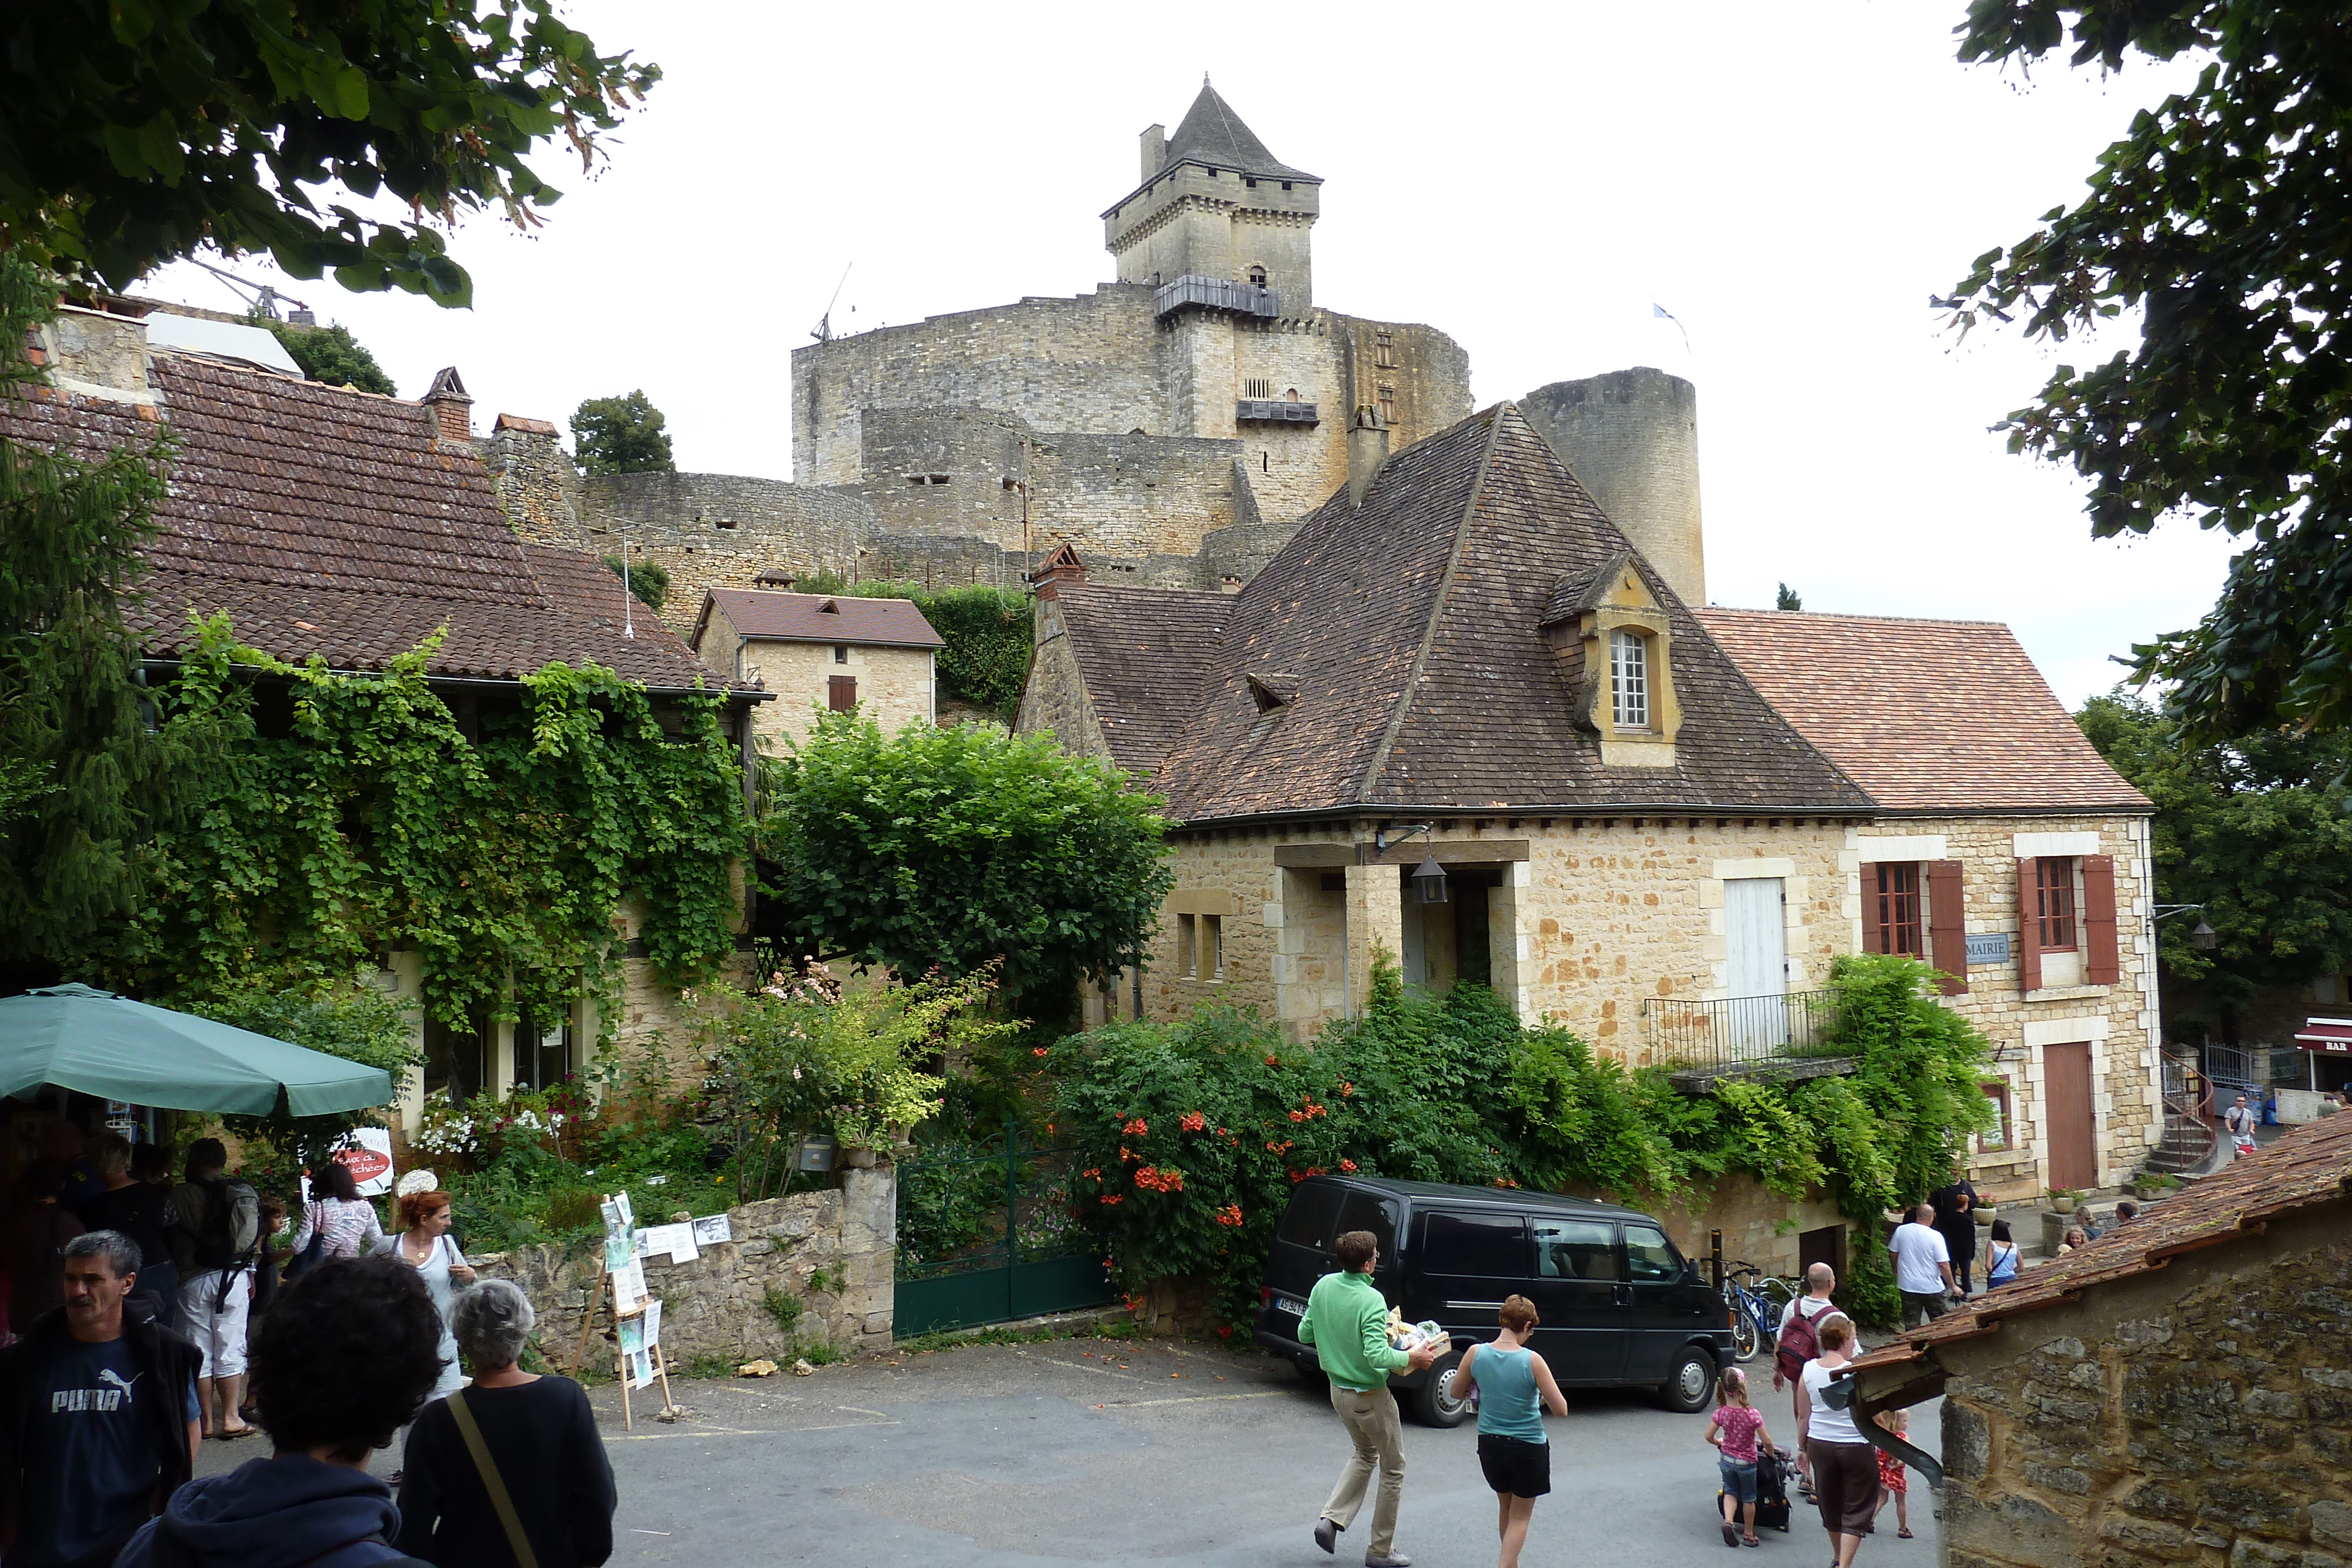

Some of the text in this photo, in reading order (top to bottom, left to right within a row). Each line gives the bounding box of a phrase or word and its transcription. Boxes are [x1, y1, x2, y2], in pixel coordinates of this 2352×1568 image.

[1966, 942, 2004, 955] MAIRIE
[2326, 1042, 2347, 1051] BAR
[350, 1163, 386, 1174] échées
[52, 1389, 121, 1413] PUMA
